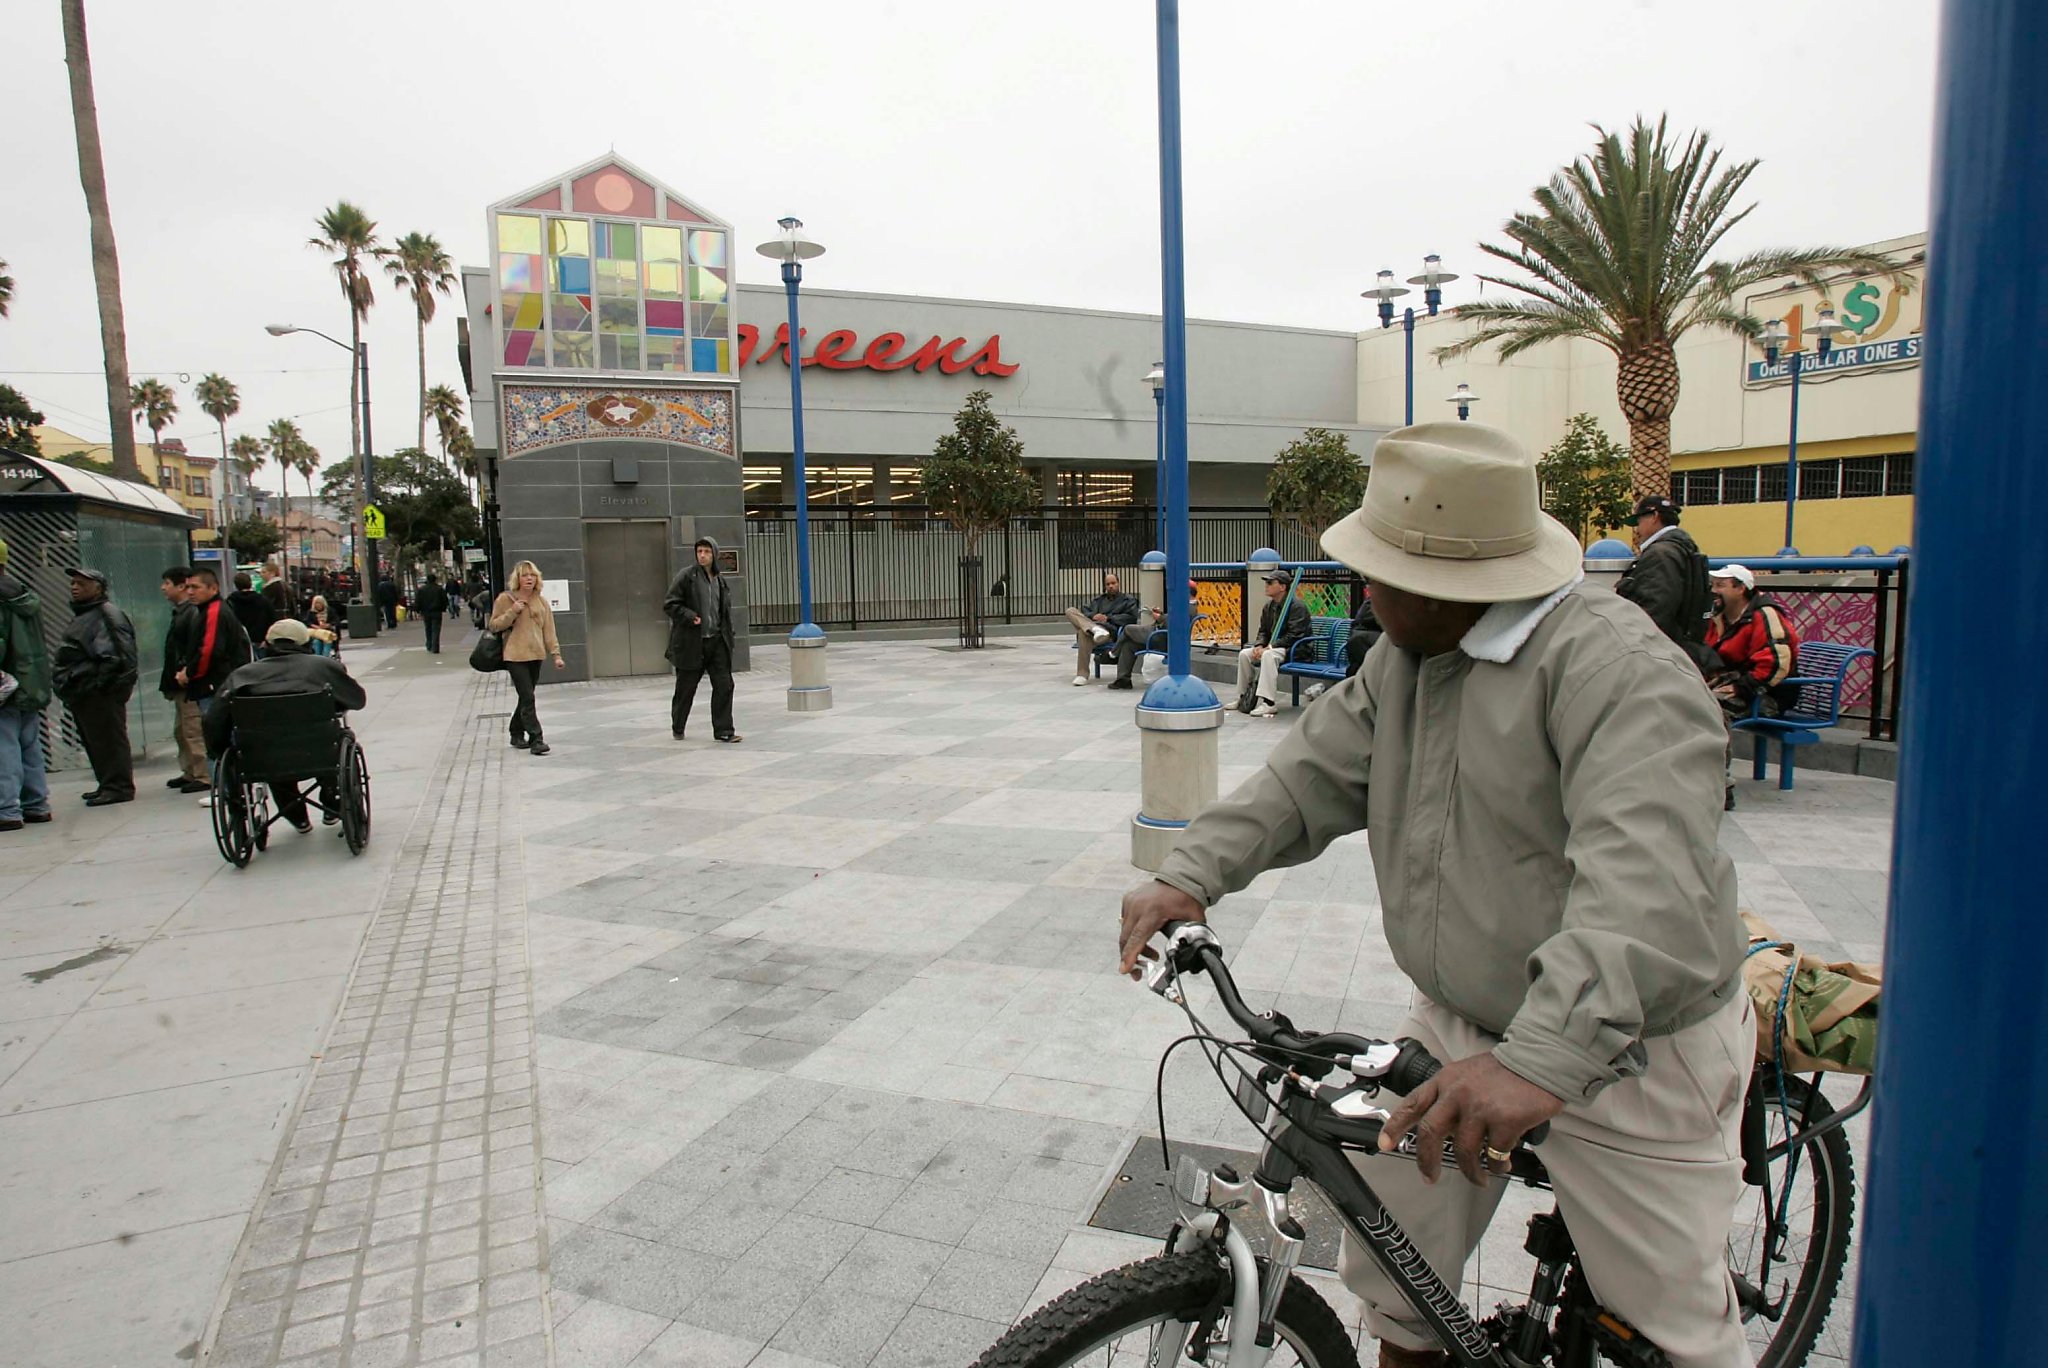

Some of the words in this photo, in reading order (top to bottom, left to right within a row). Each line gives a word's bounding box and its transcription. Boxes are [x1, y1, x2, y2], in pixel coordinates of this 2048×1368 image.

[1760, 359, 1789, 378] ONE
[1864, 342, 1899, 362] ONE
[1906, 339, 1923, 356] S
[1357, 1204, 1493, 1360] SPECIALIZED
